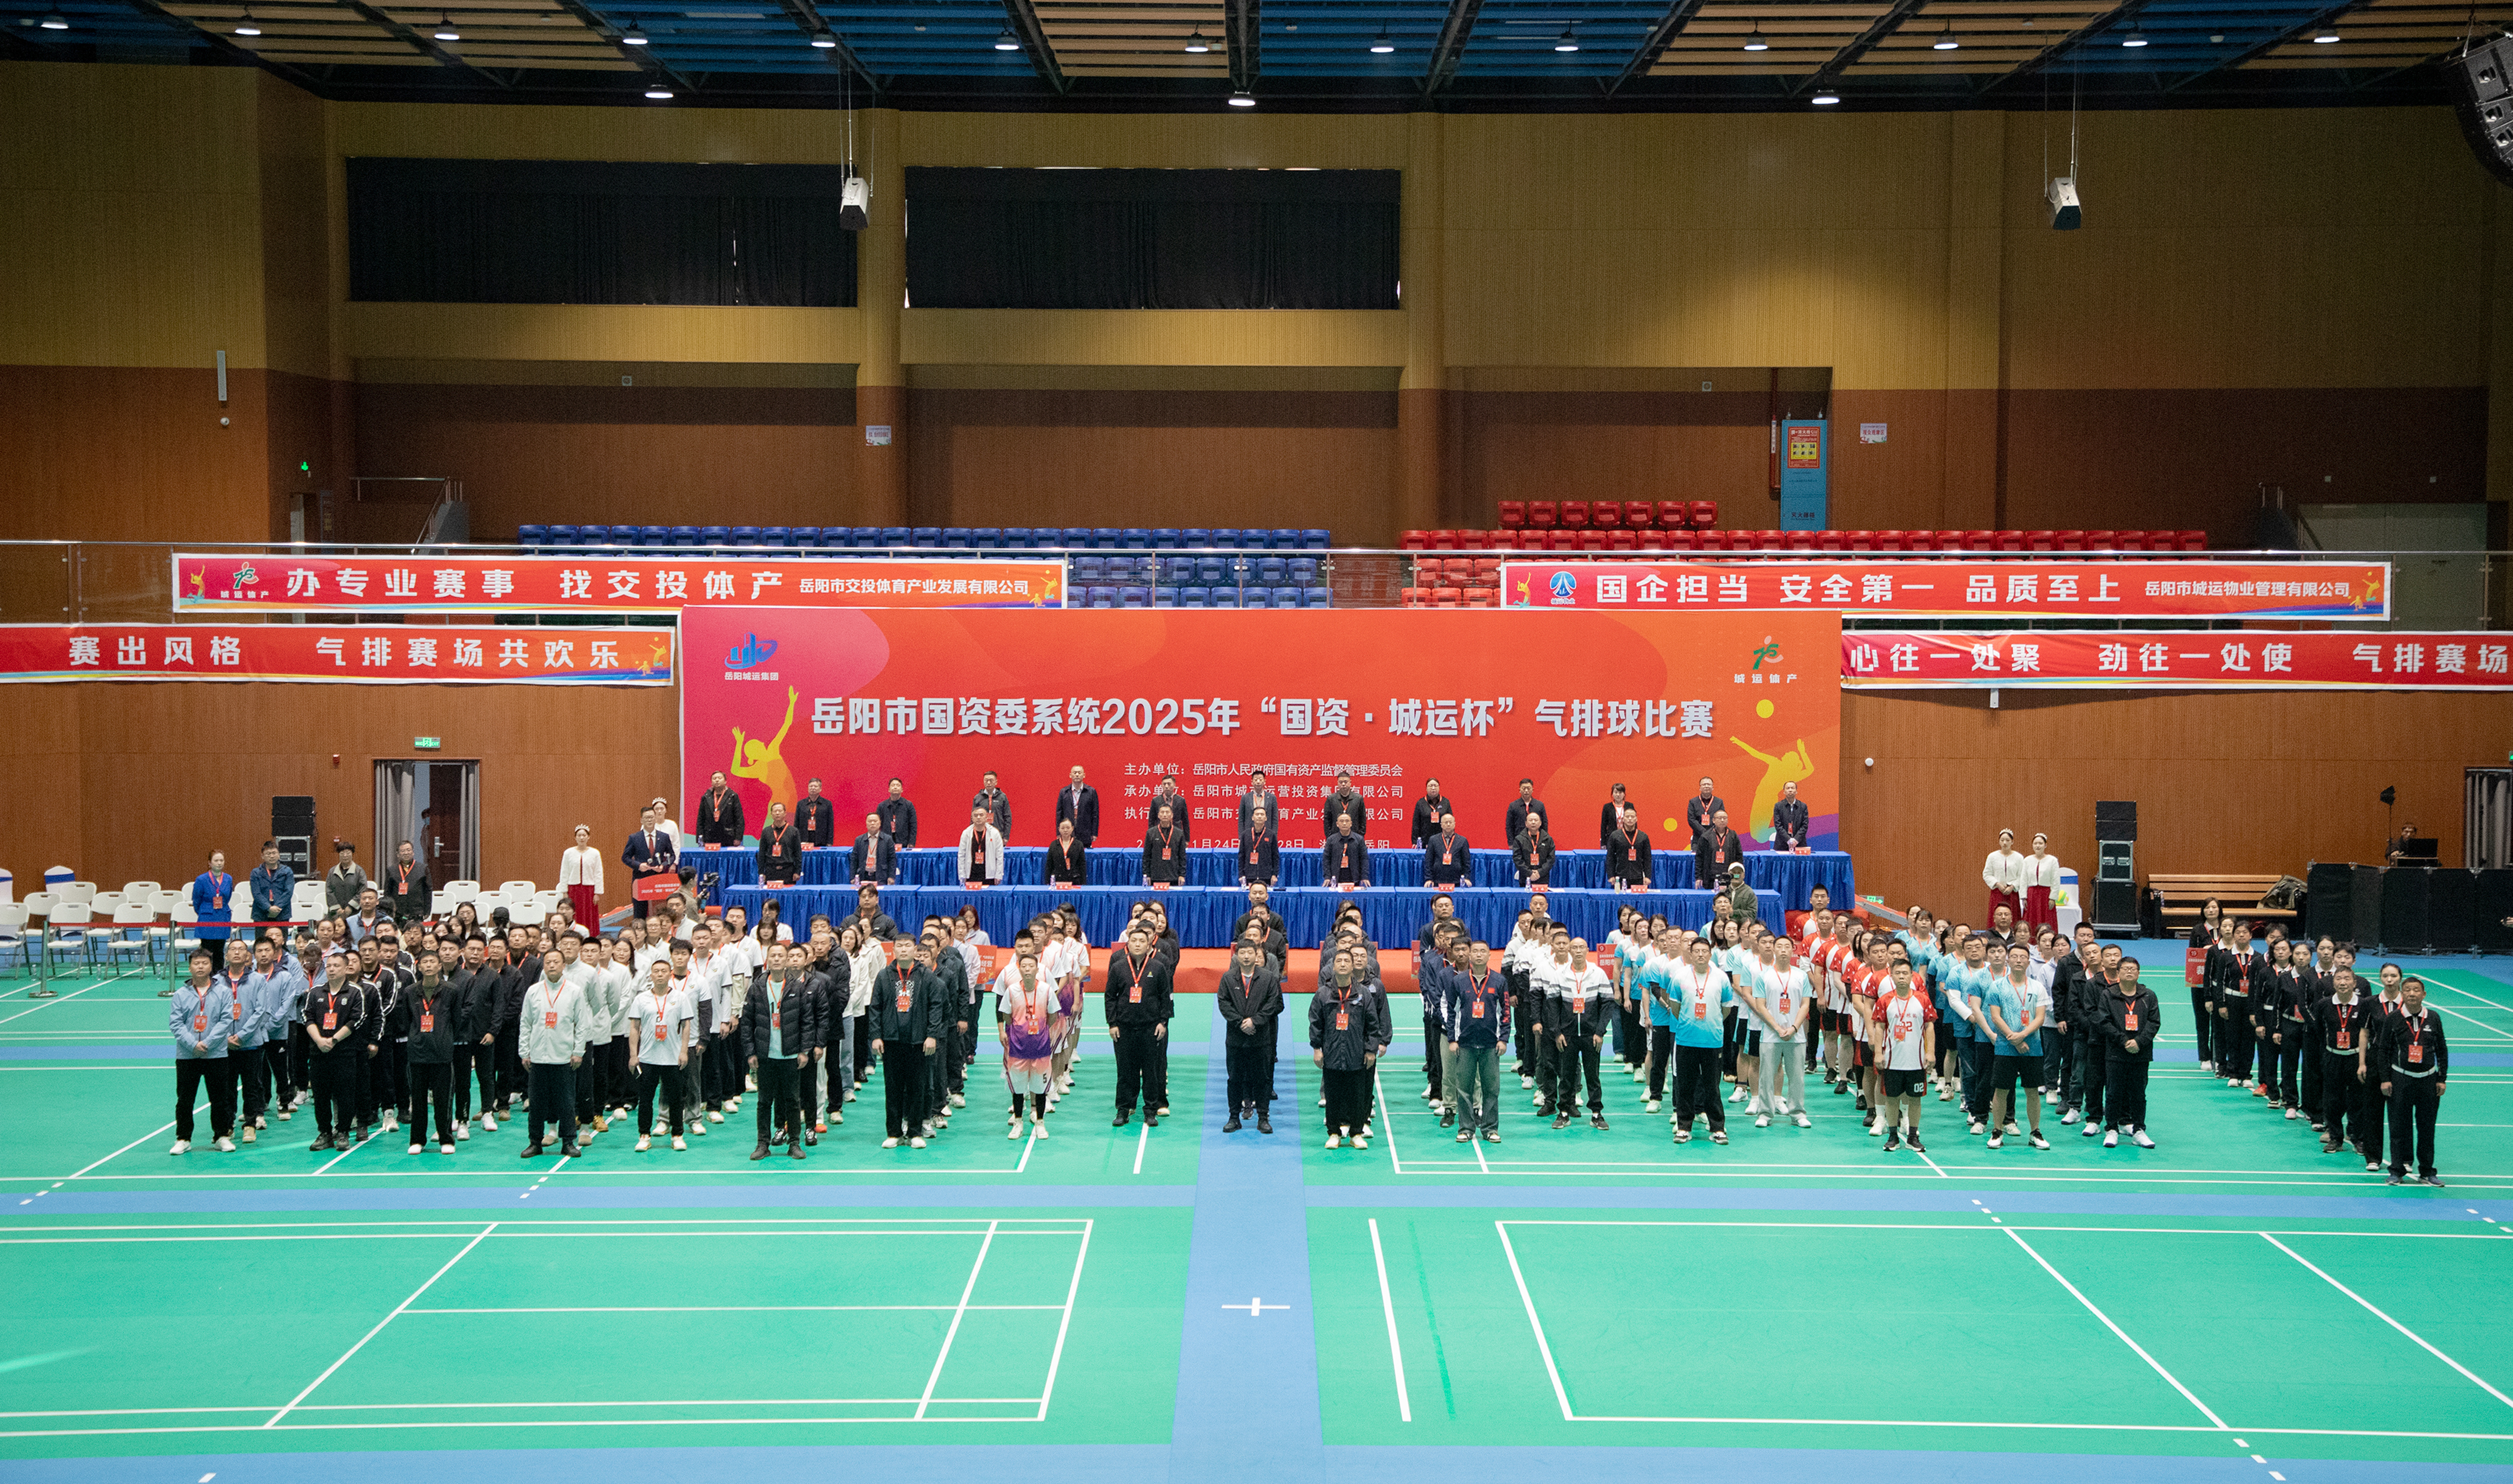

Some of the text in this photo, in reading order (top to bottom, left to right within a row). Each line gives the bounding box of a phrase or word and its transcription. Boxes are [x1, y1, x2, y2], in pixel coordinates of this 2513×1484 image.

[287, 568, 783, 600] 办专业赛事 找交投体产
[799, 578, 1029, 595] 岳阳市交投体育产业发展有限公司
[1597, 574, 2120, 603] 国企担当 安全第一 品质至上
[2145, 581, 2349, 597] 岳阳市城运物业管理有限公司
[220, 590, 269, 598] 城运体产
[69, 636, 619, 668] 赛出风格 气排赛场共欢乐
[1851, 642, 2508, 673] 心往一处聚 劲往一处使 气排赛场
[725, 671, 779, 681] 岳阳城运集团
[1734, 674, 1797, 684] 城运体产
[1193, 763, 1403, 777] 岳阳市人民政府国有资产监督管理委员会
[2027, 993, 2033, 1002] 7
[1914, 1082, 1924, 1093] 02
